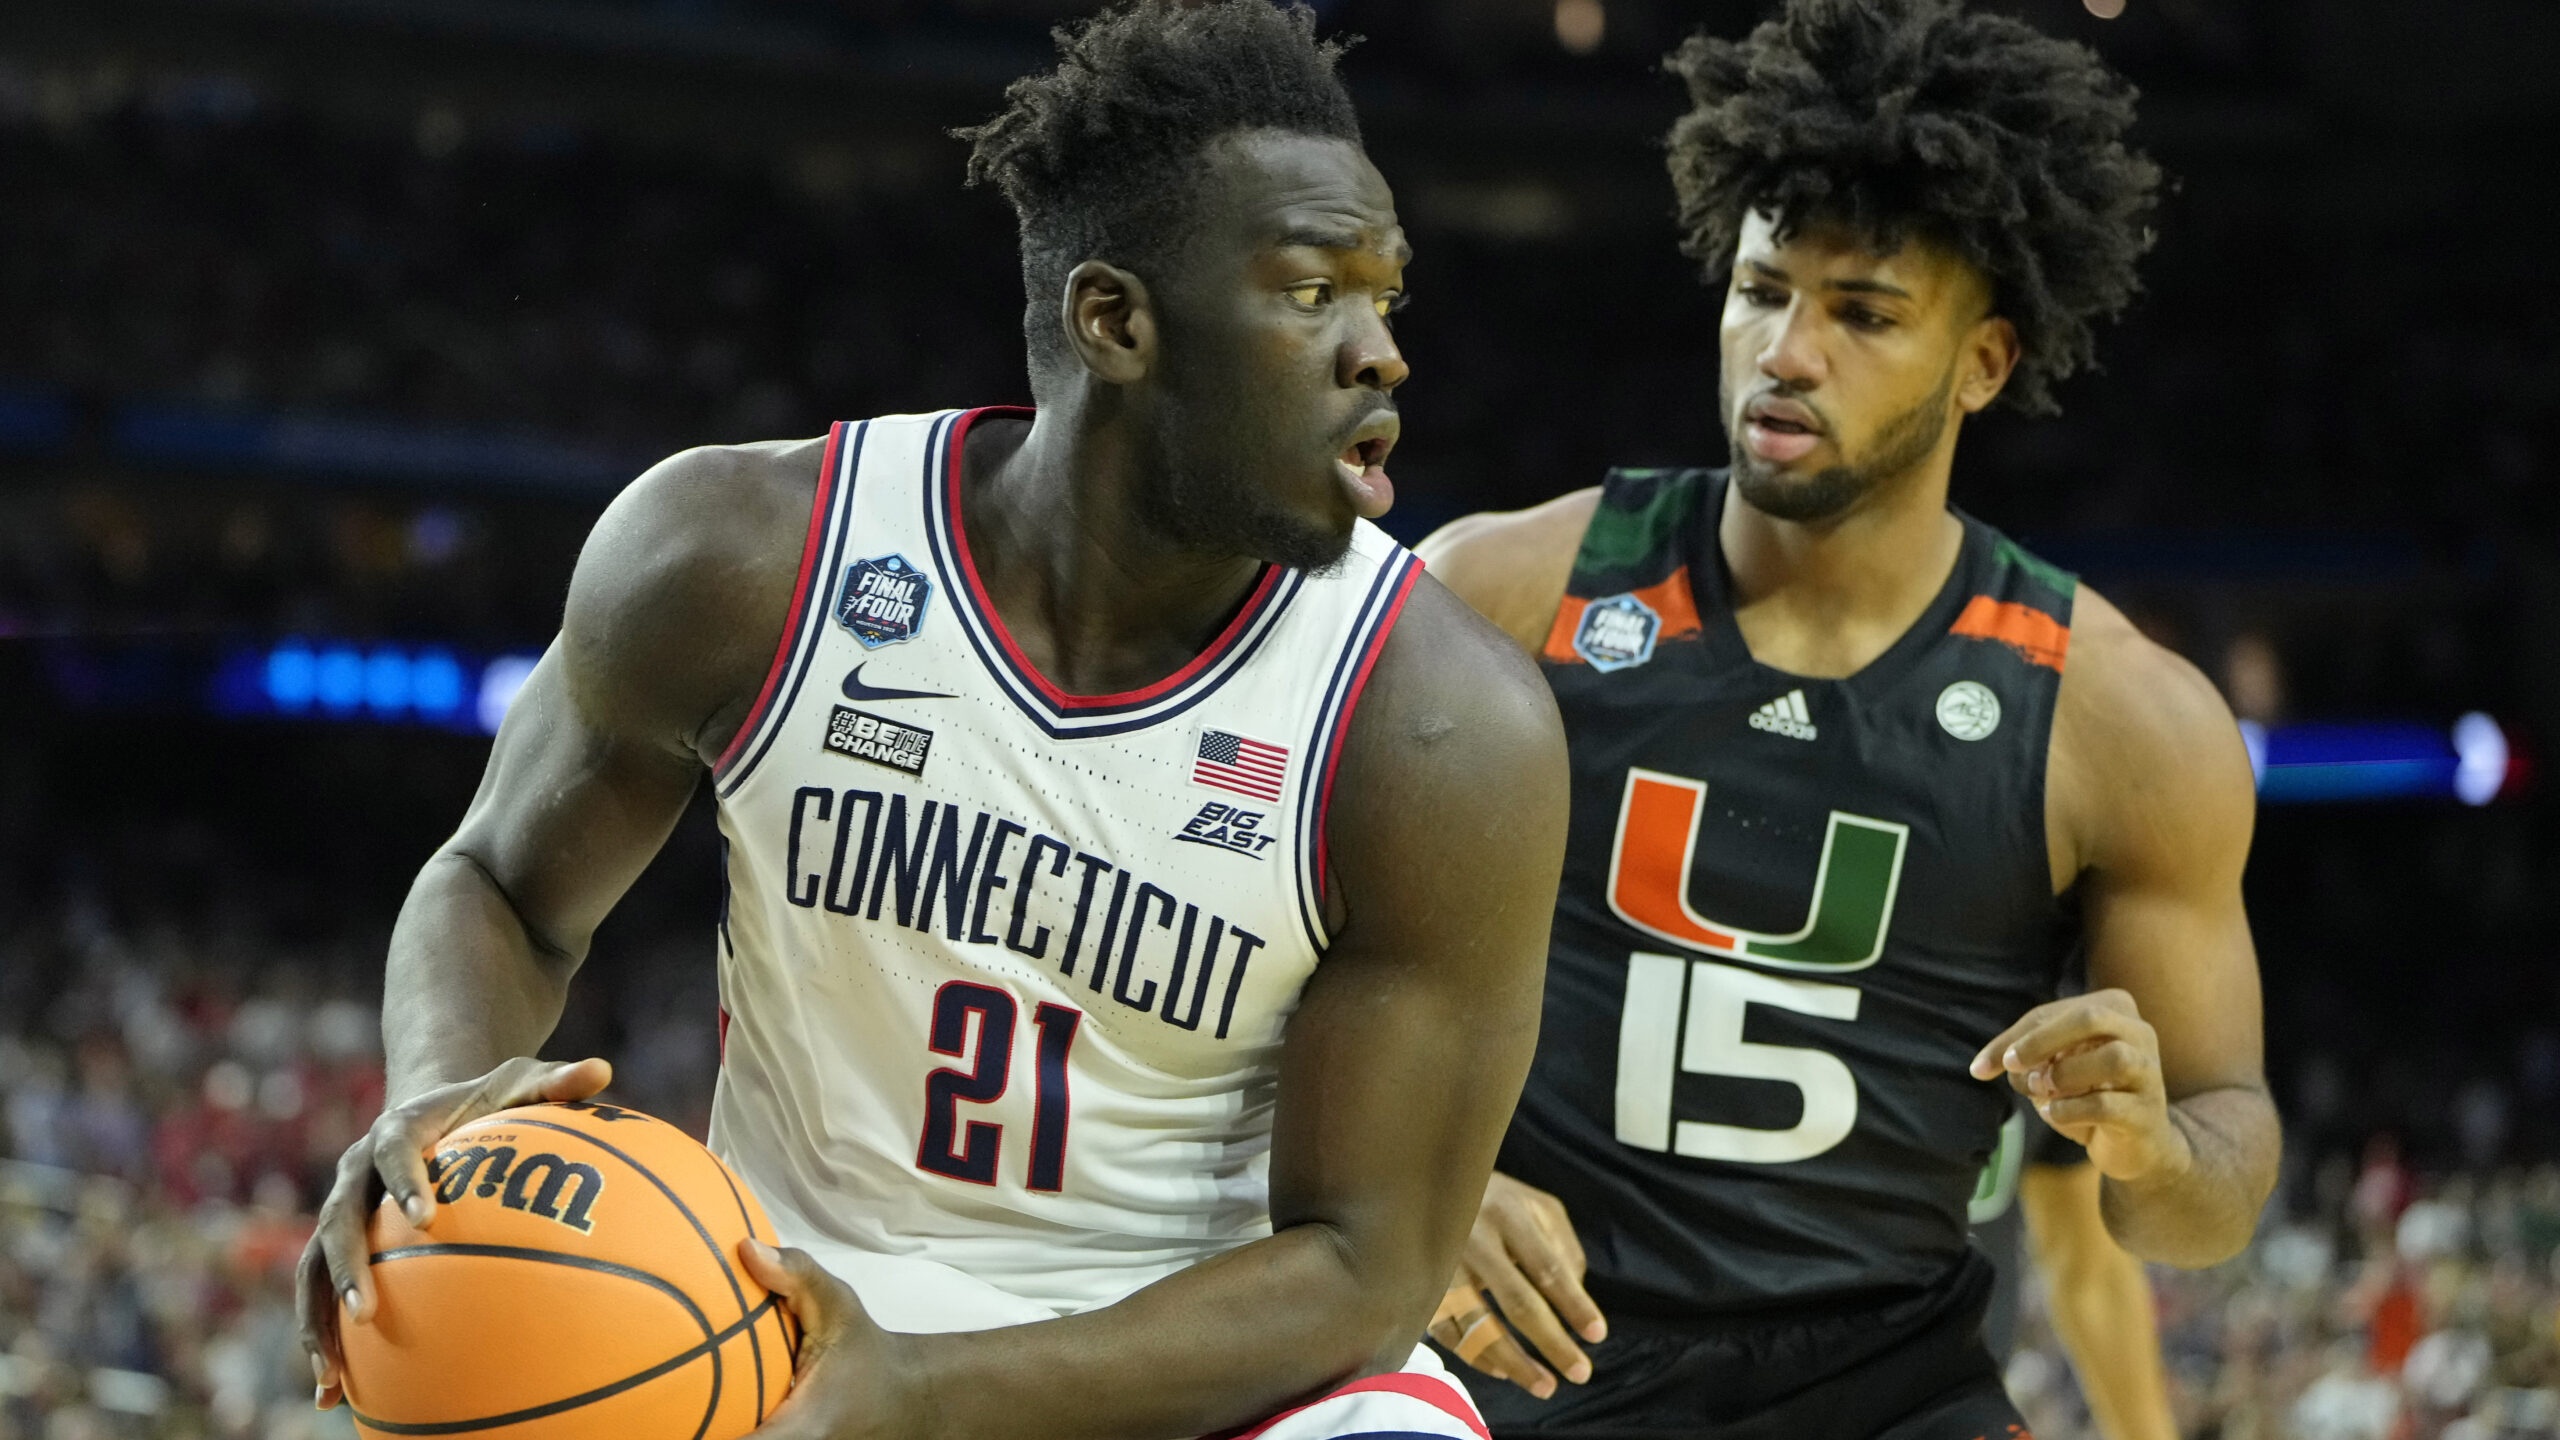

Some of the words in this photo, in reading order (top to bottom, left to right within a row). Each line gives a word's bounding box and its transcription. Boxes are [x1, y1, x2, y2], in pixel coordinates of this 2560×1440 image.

[857, 571, 917, 604] FINAL
[856, 594, 915, 626] FOUR
[828, 731, 924, 770] CHANGE
[1182, 817, 1277, 852] EAST
[1197, 801, 1265, 830] BIG
[1606, 767, 1909, 973] U
[786, 786, 1266, 1040] CONNECTICUT
[1614, 951, 1861, 1164] 15
[916, 979, 1083, 1193] 21
